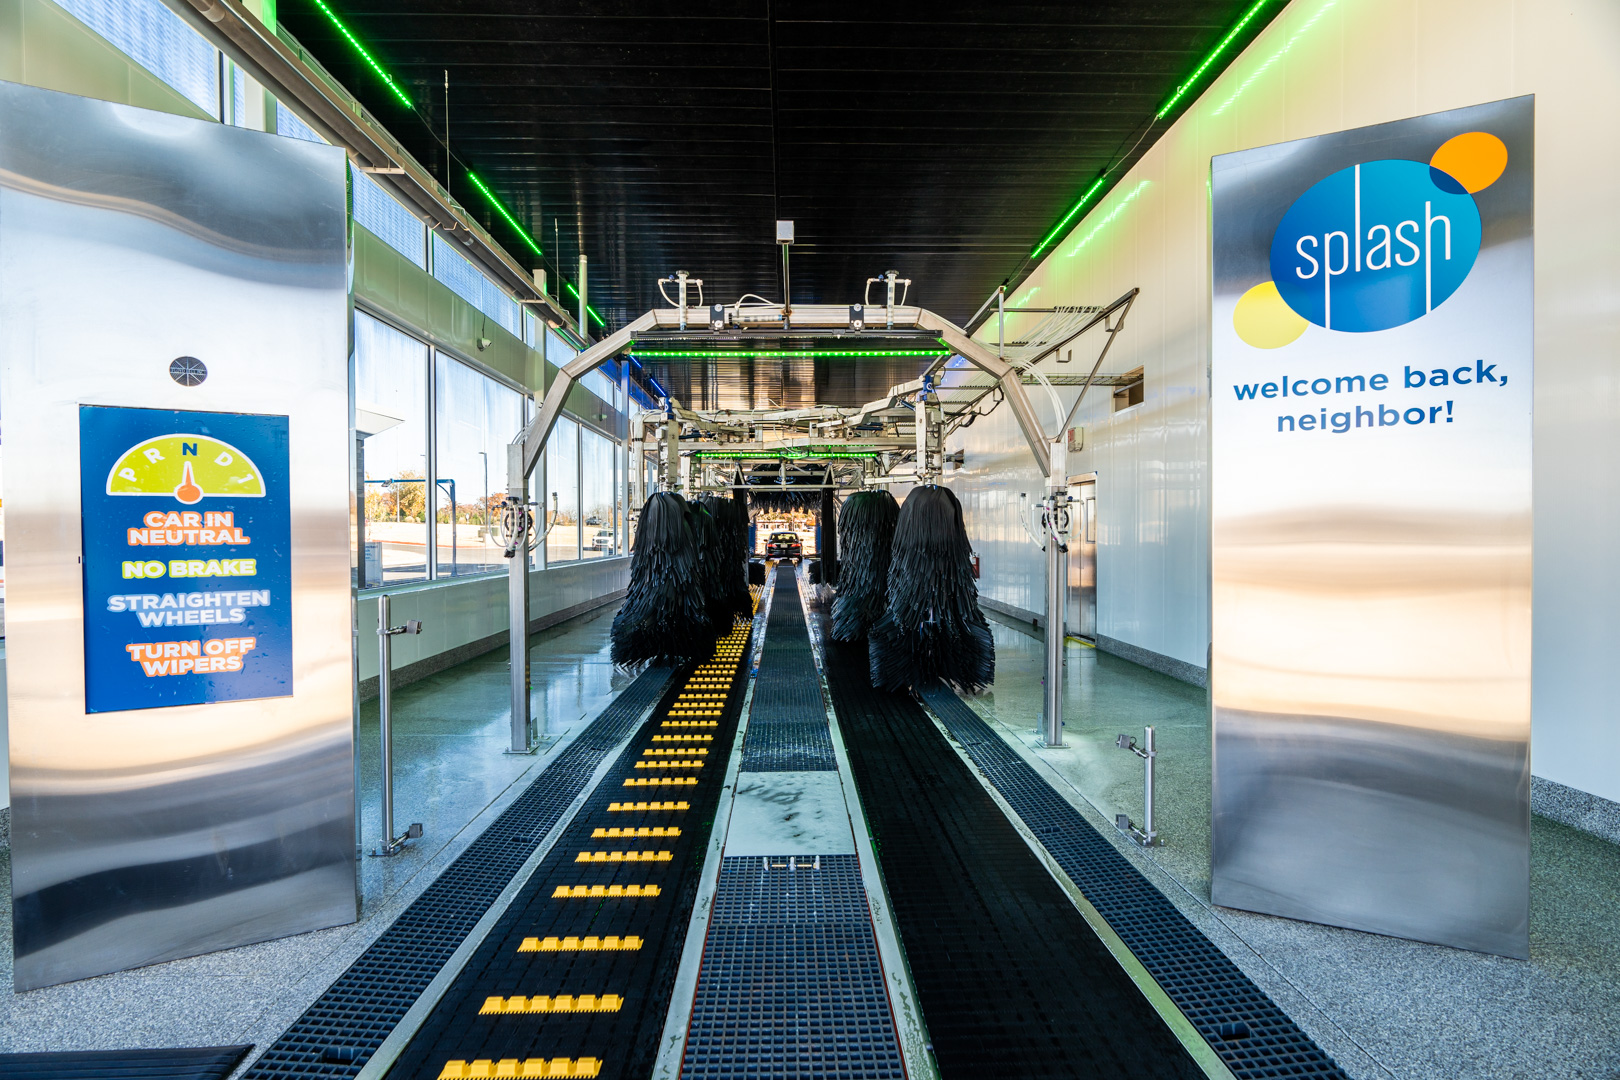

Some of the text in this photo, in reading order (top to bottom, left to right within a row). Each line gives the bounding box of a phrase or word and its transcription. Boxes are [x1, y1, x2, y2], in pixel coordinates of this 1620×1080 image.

[1295, 163, 1452, 330] splash
[1233, 359, 1508, 401] welcome back,
[1277, 400, 1454, 434] neighbor!
[118, 467, 137, 482] P
[142, 447, 166, 464] R
[182, 442, 198, 456] N
[213, 451, 233, 467] D
[146, 512, 232, 528] CAR IN
[129, 529, 249, 545] NEUTRAL
[124, 560, 255, 578] NO BRAKE
[108, 590, 269, 611] STRAIGHTEN
[138, 607, 245, 626] WHEELS
[128, 638, 254, 660] TURN OFF
[143, 655, 241, 676] WIPERS
